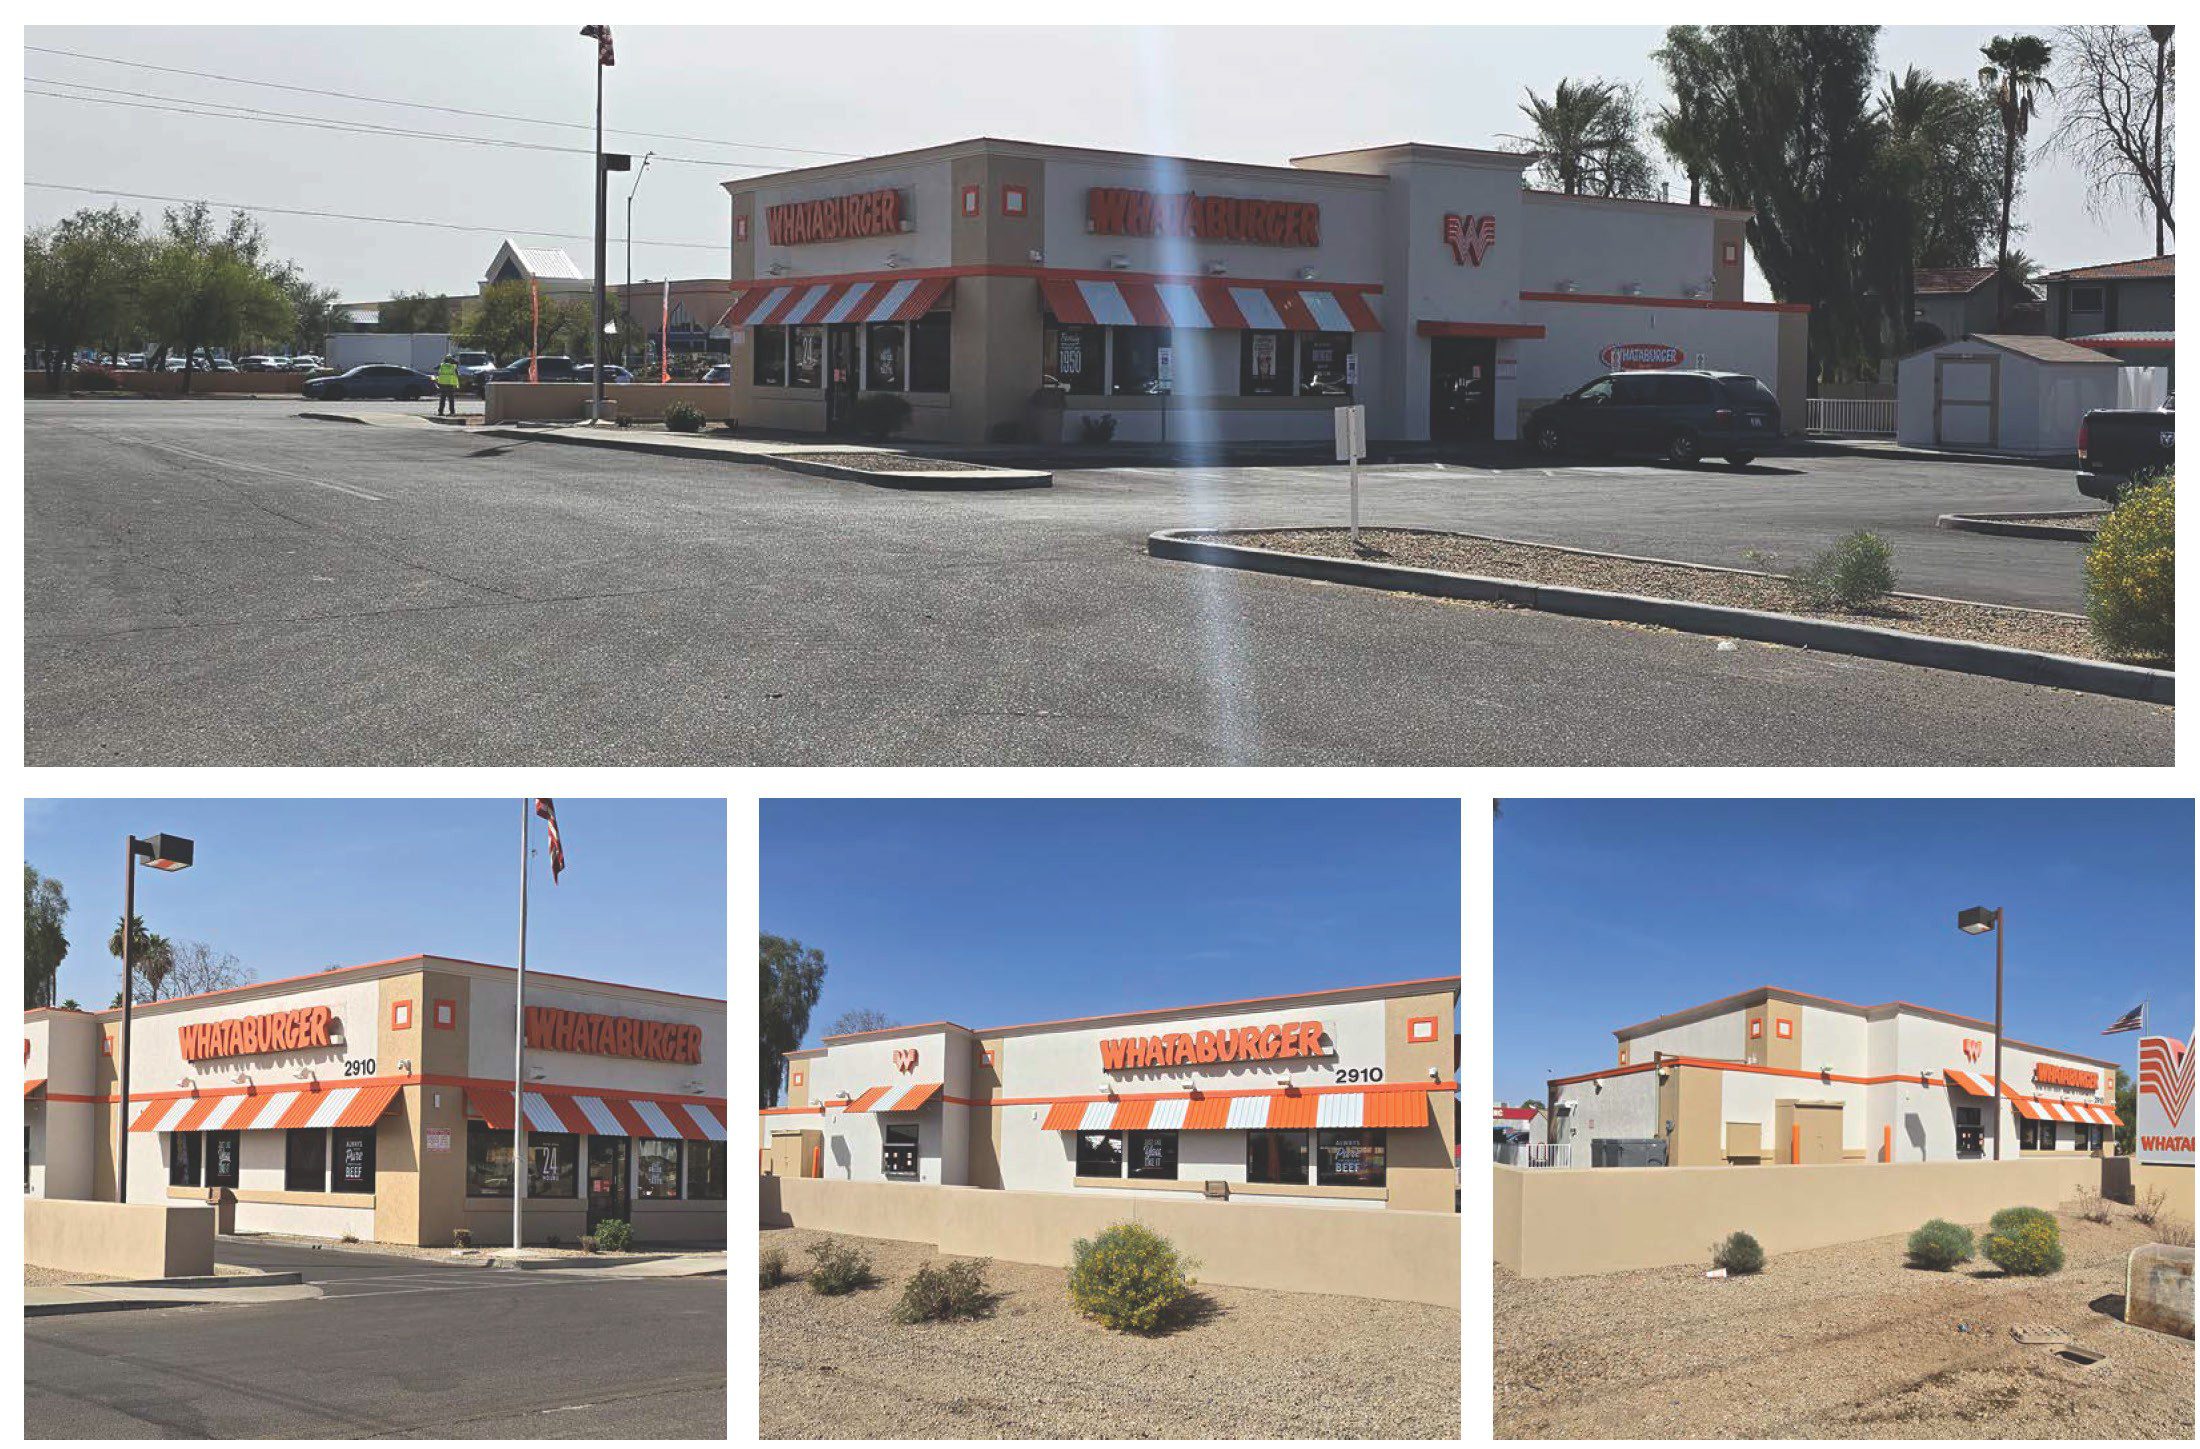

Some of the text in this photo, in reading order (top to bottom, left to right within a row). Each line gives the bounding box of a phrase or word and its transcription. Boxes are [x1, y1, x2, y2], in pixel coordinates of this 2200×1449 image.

[766, 187, 900, 246] WHATABURGER
[1088, 186, 1320, 248] WHATABURGER
[1060, 350, 1081, 373] 1950
[178, 1005, 332, 1062] WHATABURGER
[525, 1005, 702, 1064] WHATABURGER
[1100, 1020, 1325, 1071] WHATABURGER
[345, 1058, 376, 1078] 2910
[1336, 1067, 1383, 1085] 2910
[2036, 1062, 2100, 1090] WHATABURGER
[345, 1166, 362, 1178] BEEF
[543, 1147, 557, 1174] 24
[1335, 1163, 1359, 1173] BEEF
